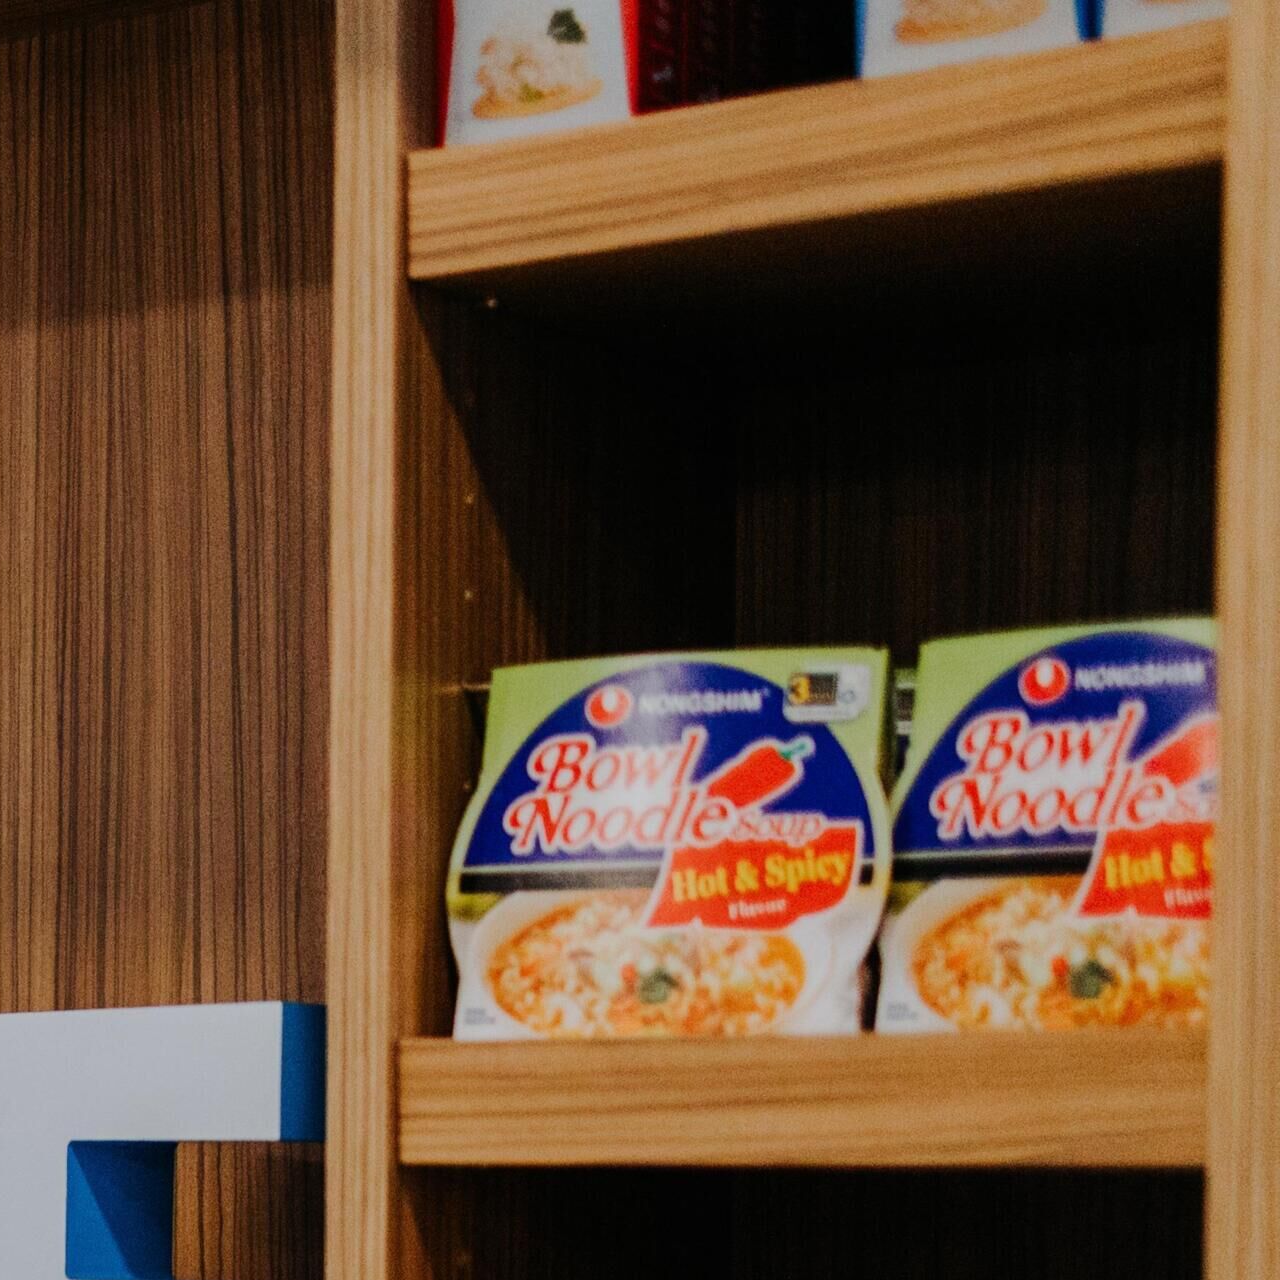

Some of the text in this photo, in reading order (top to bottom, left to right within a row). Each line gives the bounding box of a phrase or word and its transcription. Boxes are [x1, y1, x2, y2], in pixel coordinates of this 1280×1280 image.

[1073, 661, 1206, 691] NONGSHIM
[530, 728, 704, 795] Bowl
[960, 704, 1140, 775] Bowl
[506, 790, 732, 851] Noodle
[934, 766, 1170, 834] Noodle
[672, 846, 851, 903] Hot & Spicy
[1103, 851, 1165, 890] Hot
